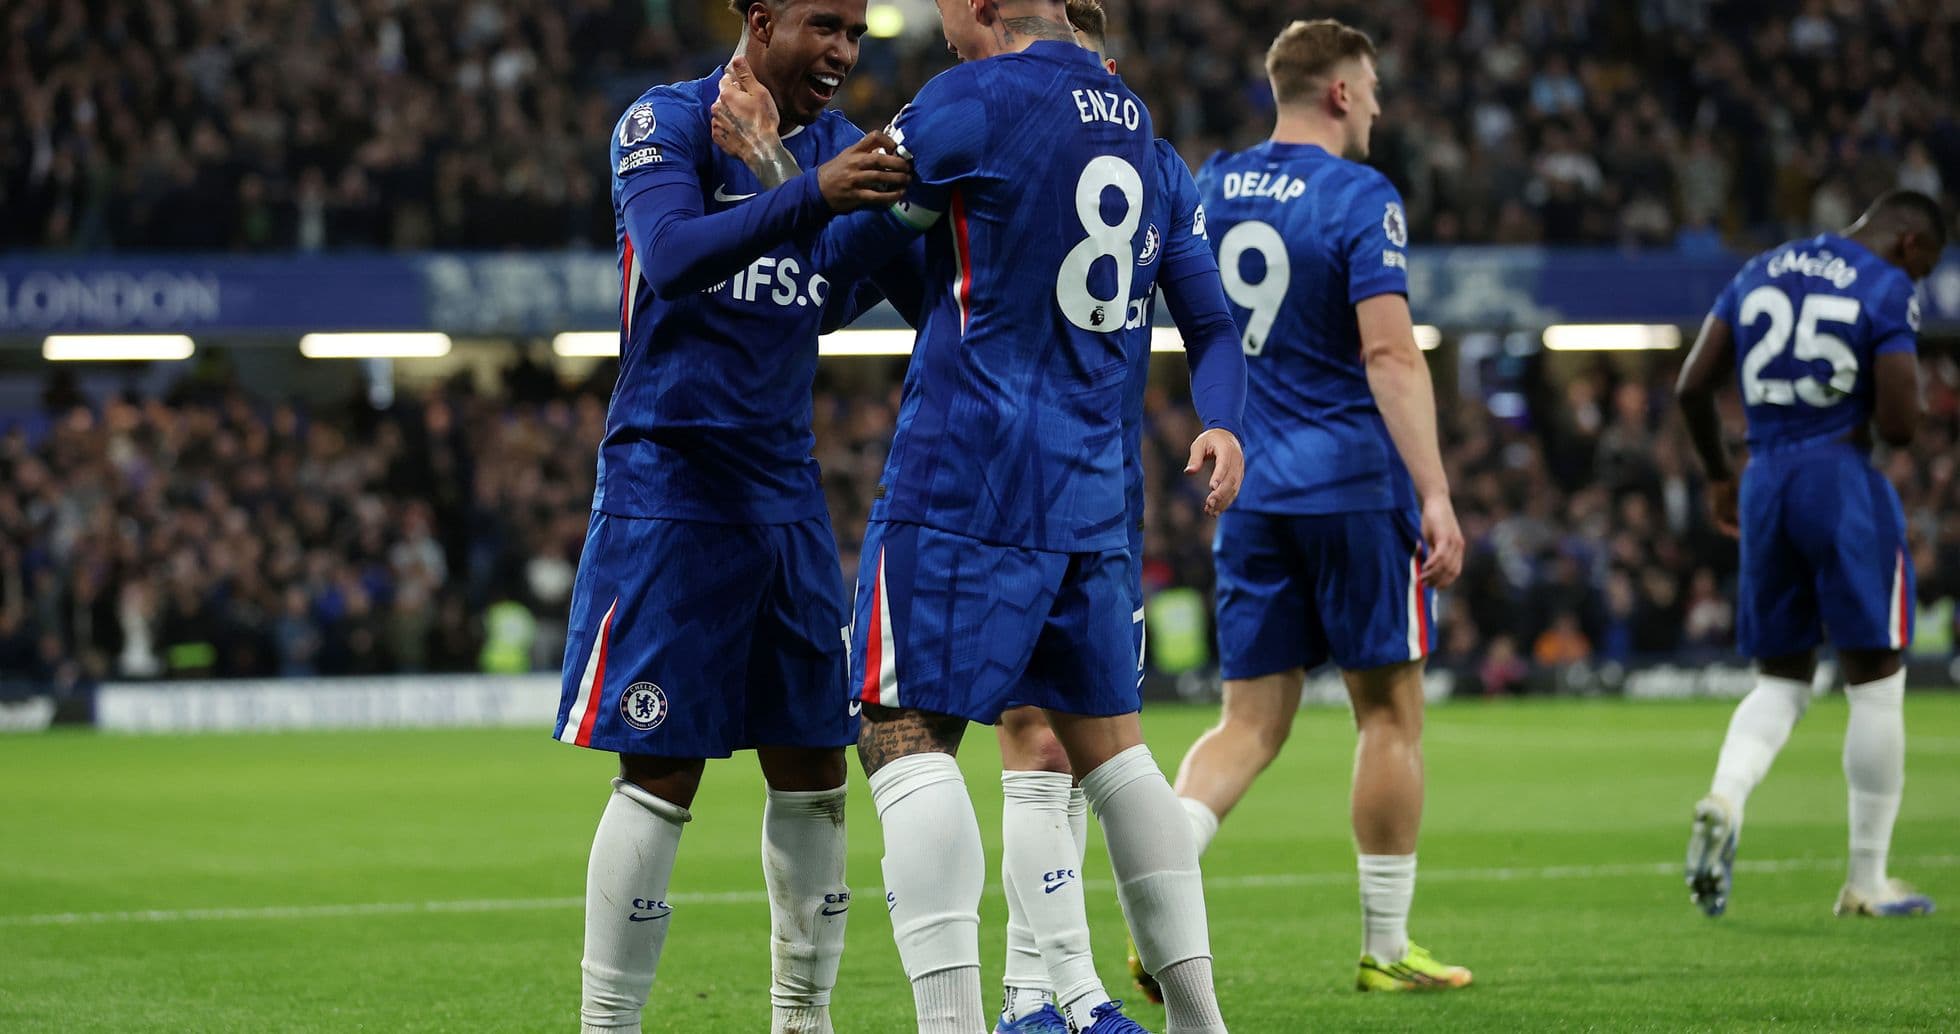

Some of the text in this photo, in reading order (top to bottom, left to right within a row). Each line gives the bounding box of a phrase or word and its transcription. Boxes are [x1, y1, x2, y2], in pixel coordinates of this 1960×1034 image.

[1071, 88, 1140, 132] ENZO
[630, 147, 657, 161] room
[1223, 171, 1307, 203] DELAP
[1056, 155, 1144, 333] 8
[1218, 220, 1291, 357] 9
[1738, 285, 1861, 407] 25
[630, 684, 660, 696] CHELSEA
[1043, 869, 1075, 882] CFC
[632, 898, 669, 910] CFC
